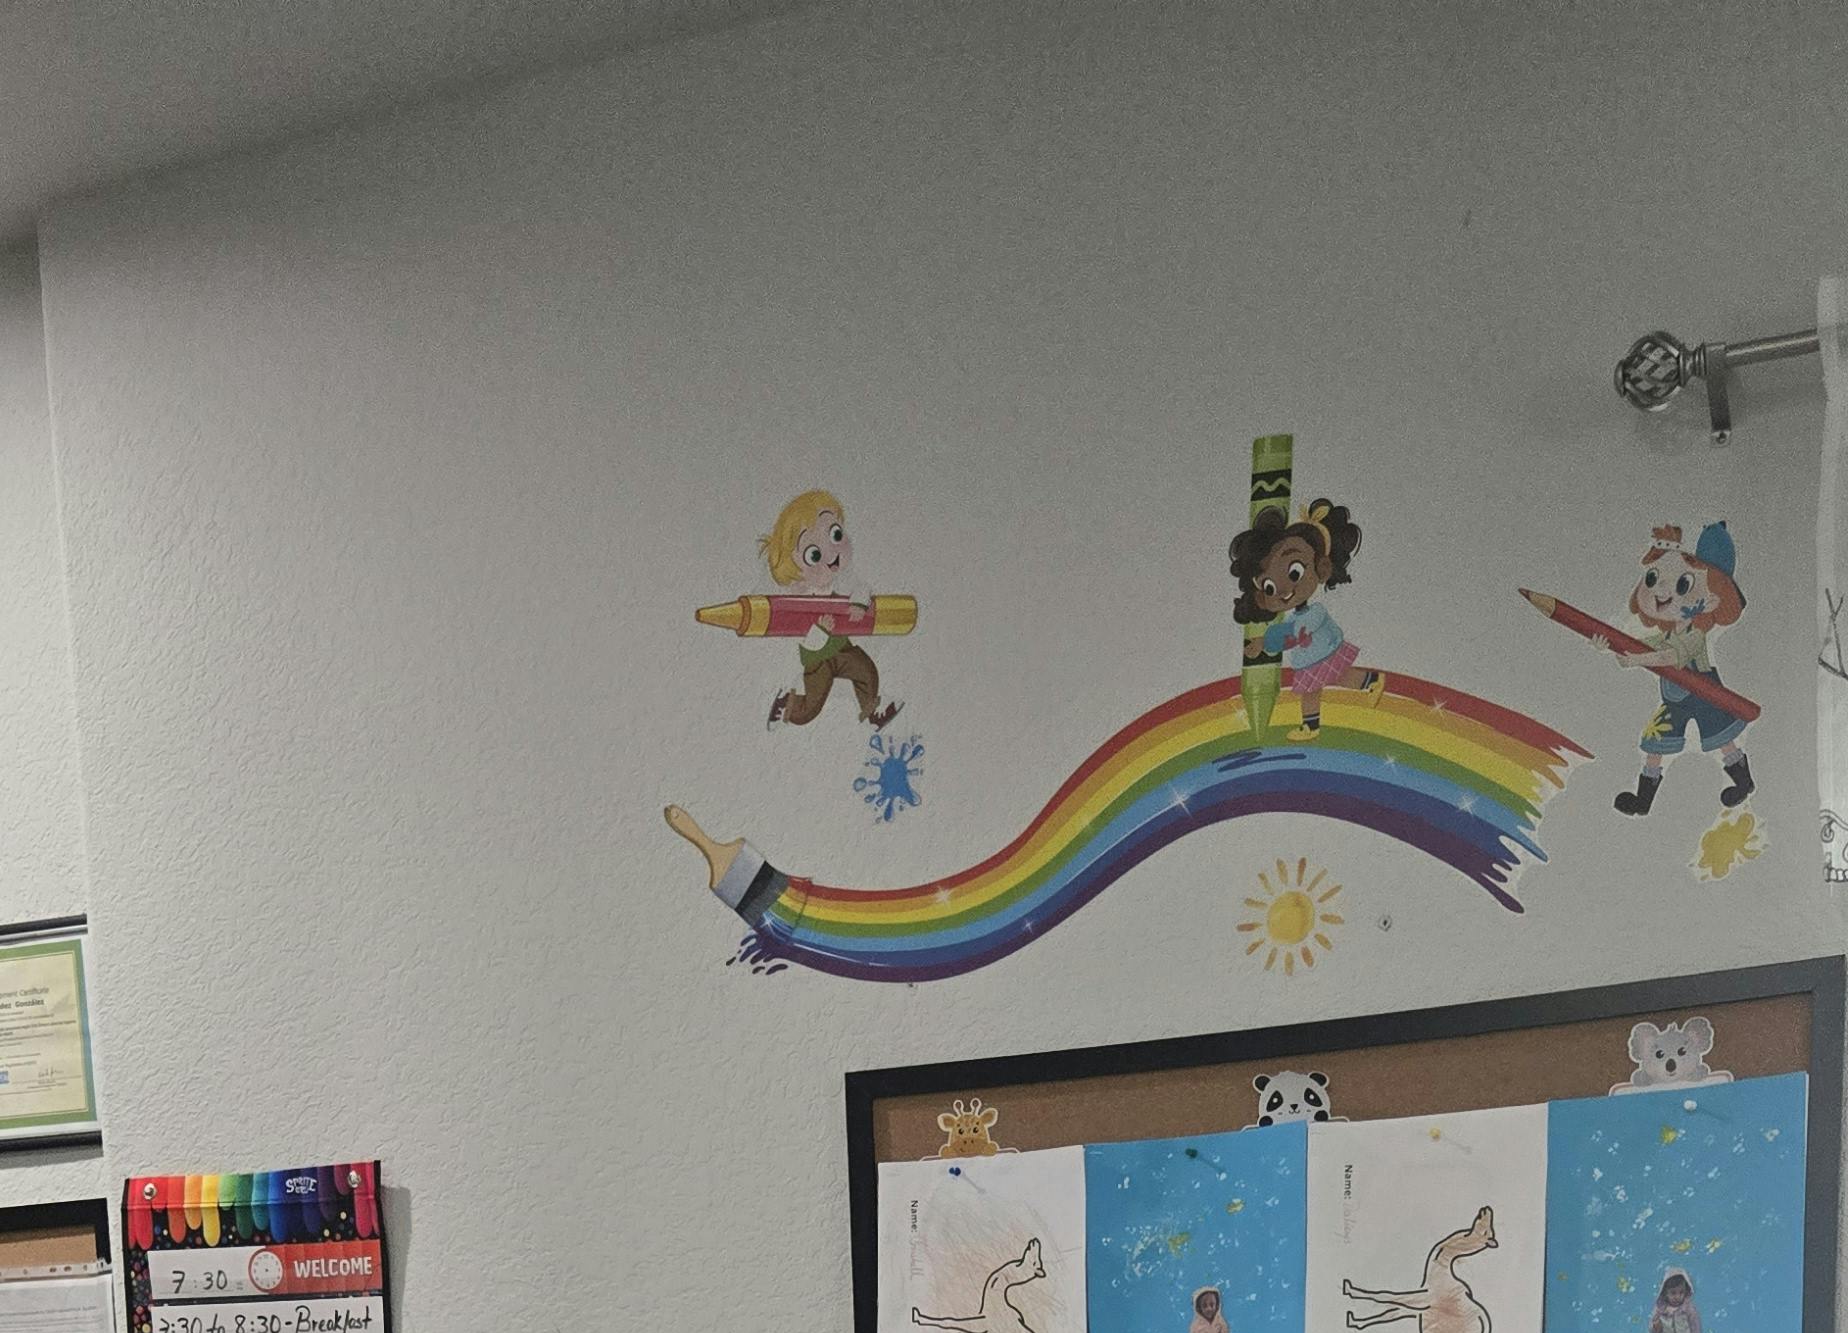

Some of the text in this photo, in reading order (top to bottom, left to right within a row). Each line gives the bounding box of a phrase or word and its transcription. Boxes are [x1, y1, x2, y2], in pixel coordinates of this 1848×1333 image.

[1344, 1164, 1353, 1200] Name:
[910, 1200, 919, 1233] Name:
[293, 1256, 372, 1279] WELCOME
